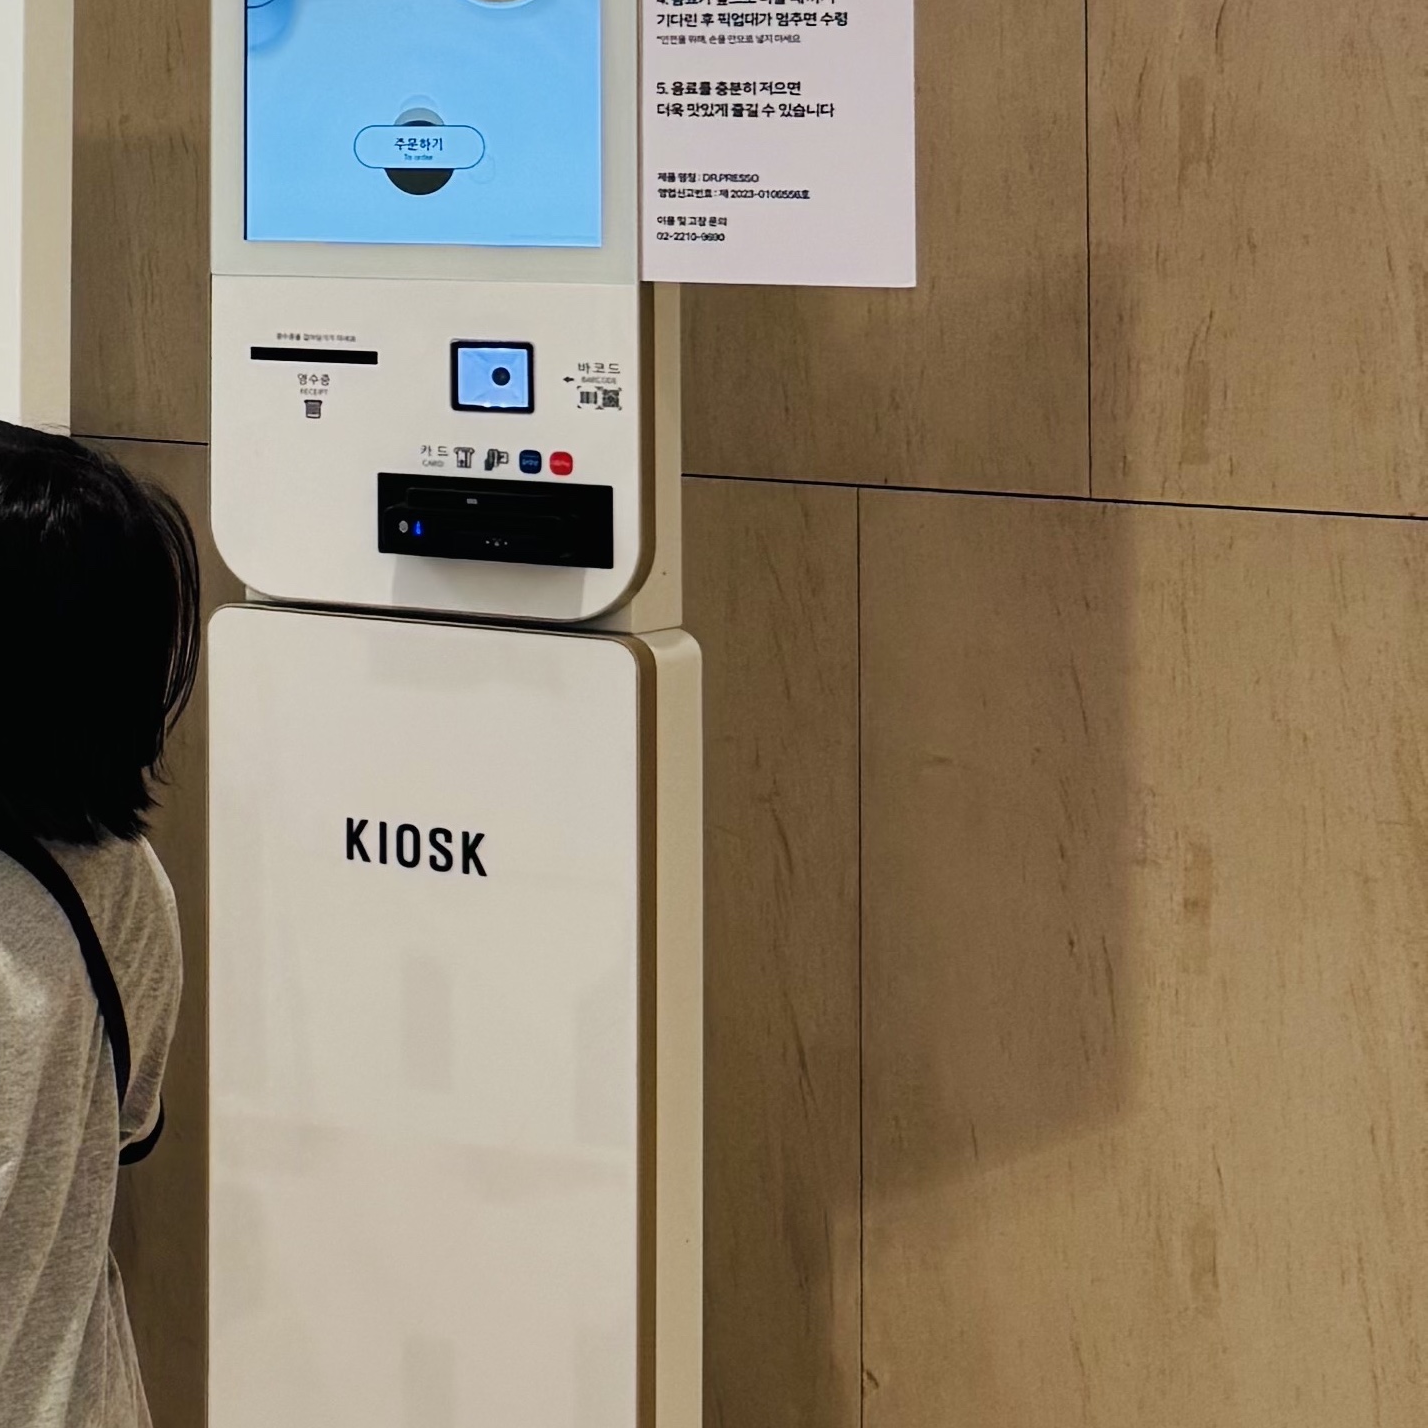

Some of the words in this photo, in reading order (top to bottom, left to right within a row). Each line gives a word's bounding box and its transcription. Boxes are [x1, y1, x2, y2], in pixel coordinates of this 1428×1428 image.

[657, 13, 697, 27] 기다린
[700, 13, 714, 27] 후
[718, 12, 772, 27] 픽업대가
[776, 12, 817, 27] 멈추면
[820, 12, 848, 26] 수령
[656, 82, 668, 94] 5.
[671, 81, 712, 96] 음료를
[715, 81, 756, 96] 충분히
[759, 81, 801, 96] 저으면
[657, 103, 684, 117] 더욱
[687, 103, 728, 117] 맛있게
[731, 103, 758, 118] 즐길
[761, 103, 775, 117] 수
[779, 103, 835, 117] 있습니다
[394, 137, 443, 151] 주문하기
[346, 817, 488, 877] KIOSK
